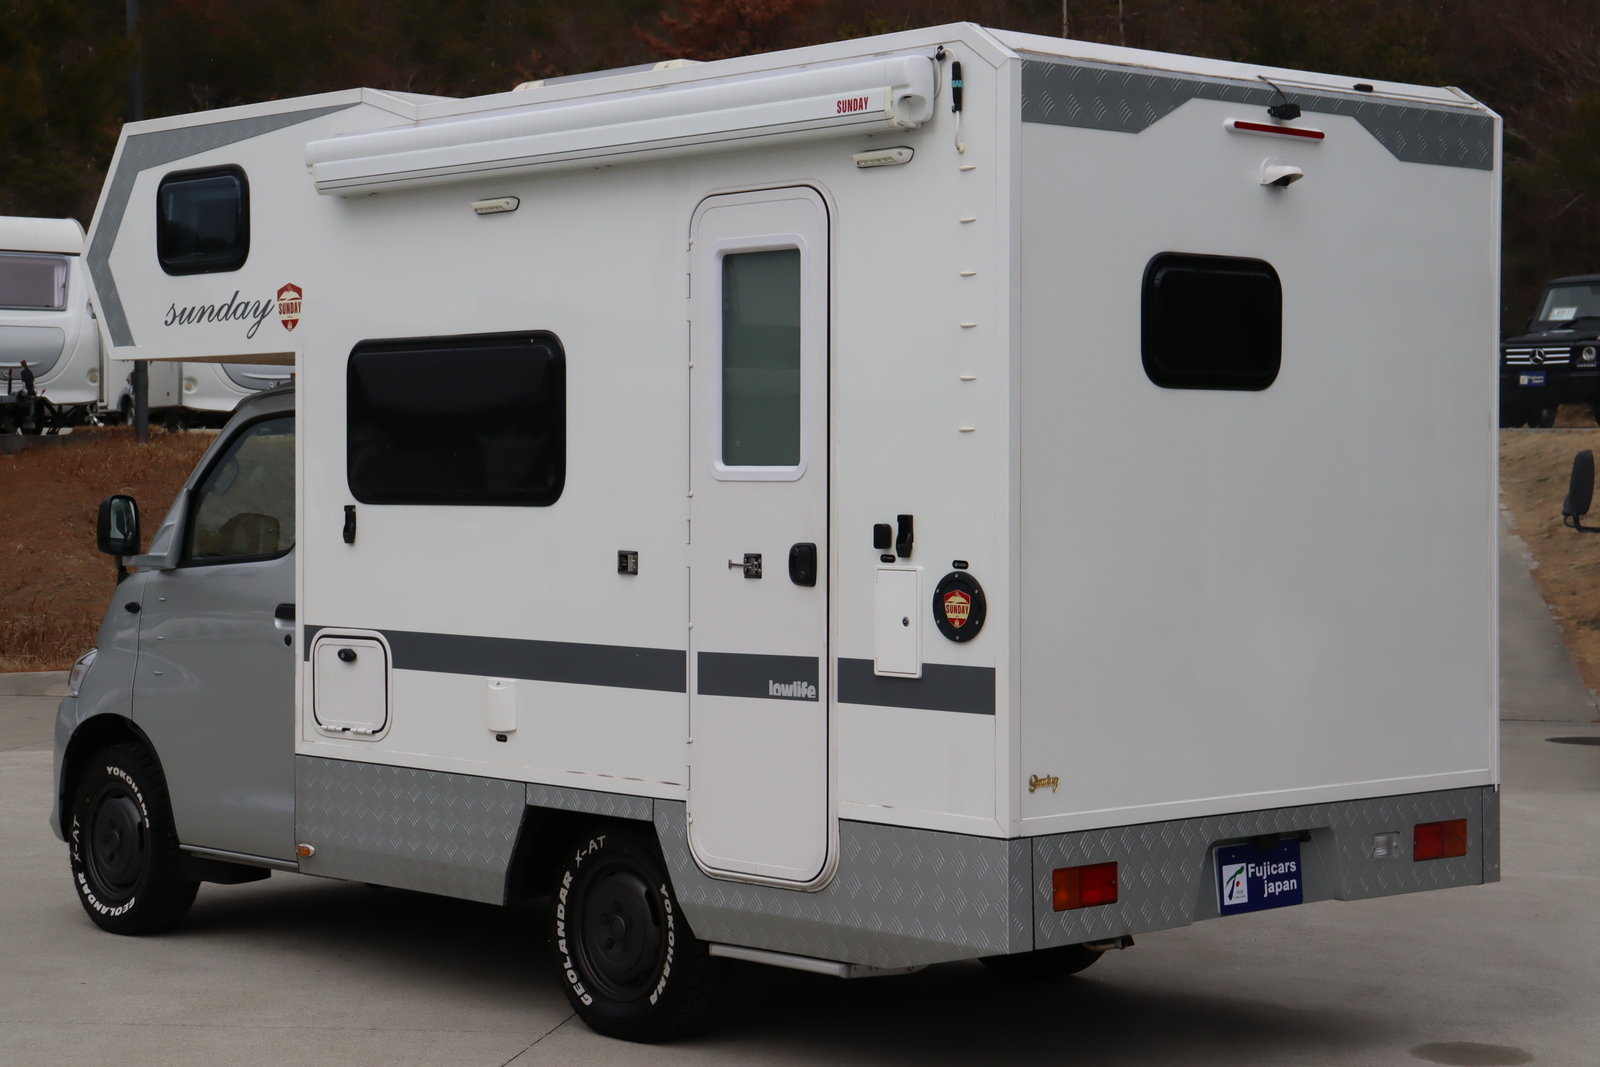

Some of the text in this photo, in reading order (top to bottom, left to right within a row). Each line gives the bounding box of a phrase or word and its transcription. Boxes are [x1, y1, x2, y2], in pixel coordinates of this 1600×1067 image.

[836, 96, 869, 114] SUNDAY
[164, 290, 275, 339] sunday
[278, 301, 302, 315] SUNDAY
[945, 604, 969, 615] SUNDAY
[768, 680, 816, 699] lowlife
[106, 766, 150, 829] YOKOHAMA
[72, 815, 136, 916] GEOLANDAR X-AT
[1247, 861, 1297, 879] Fujicars
[1263, 879, 1298, 897] japan
[556, 835, 607, 1006] GEOLANDAR X-AT
[650, 883, 675, 1006] YOKOHAMA
